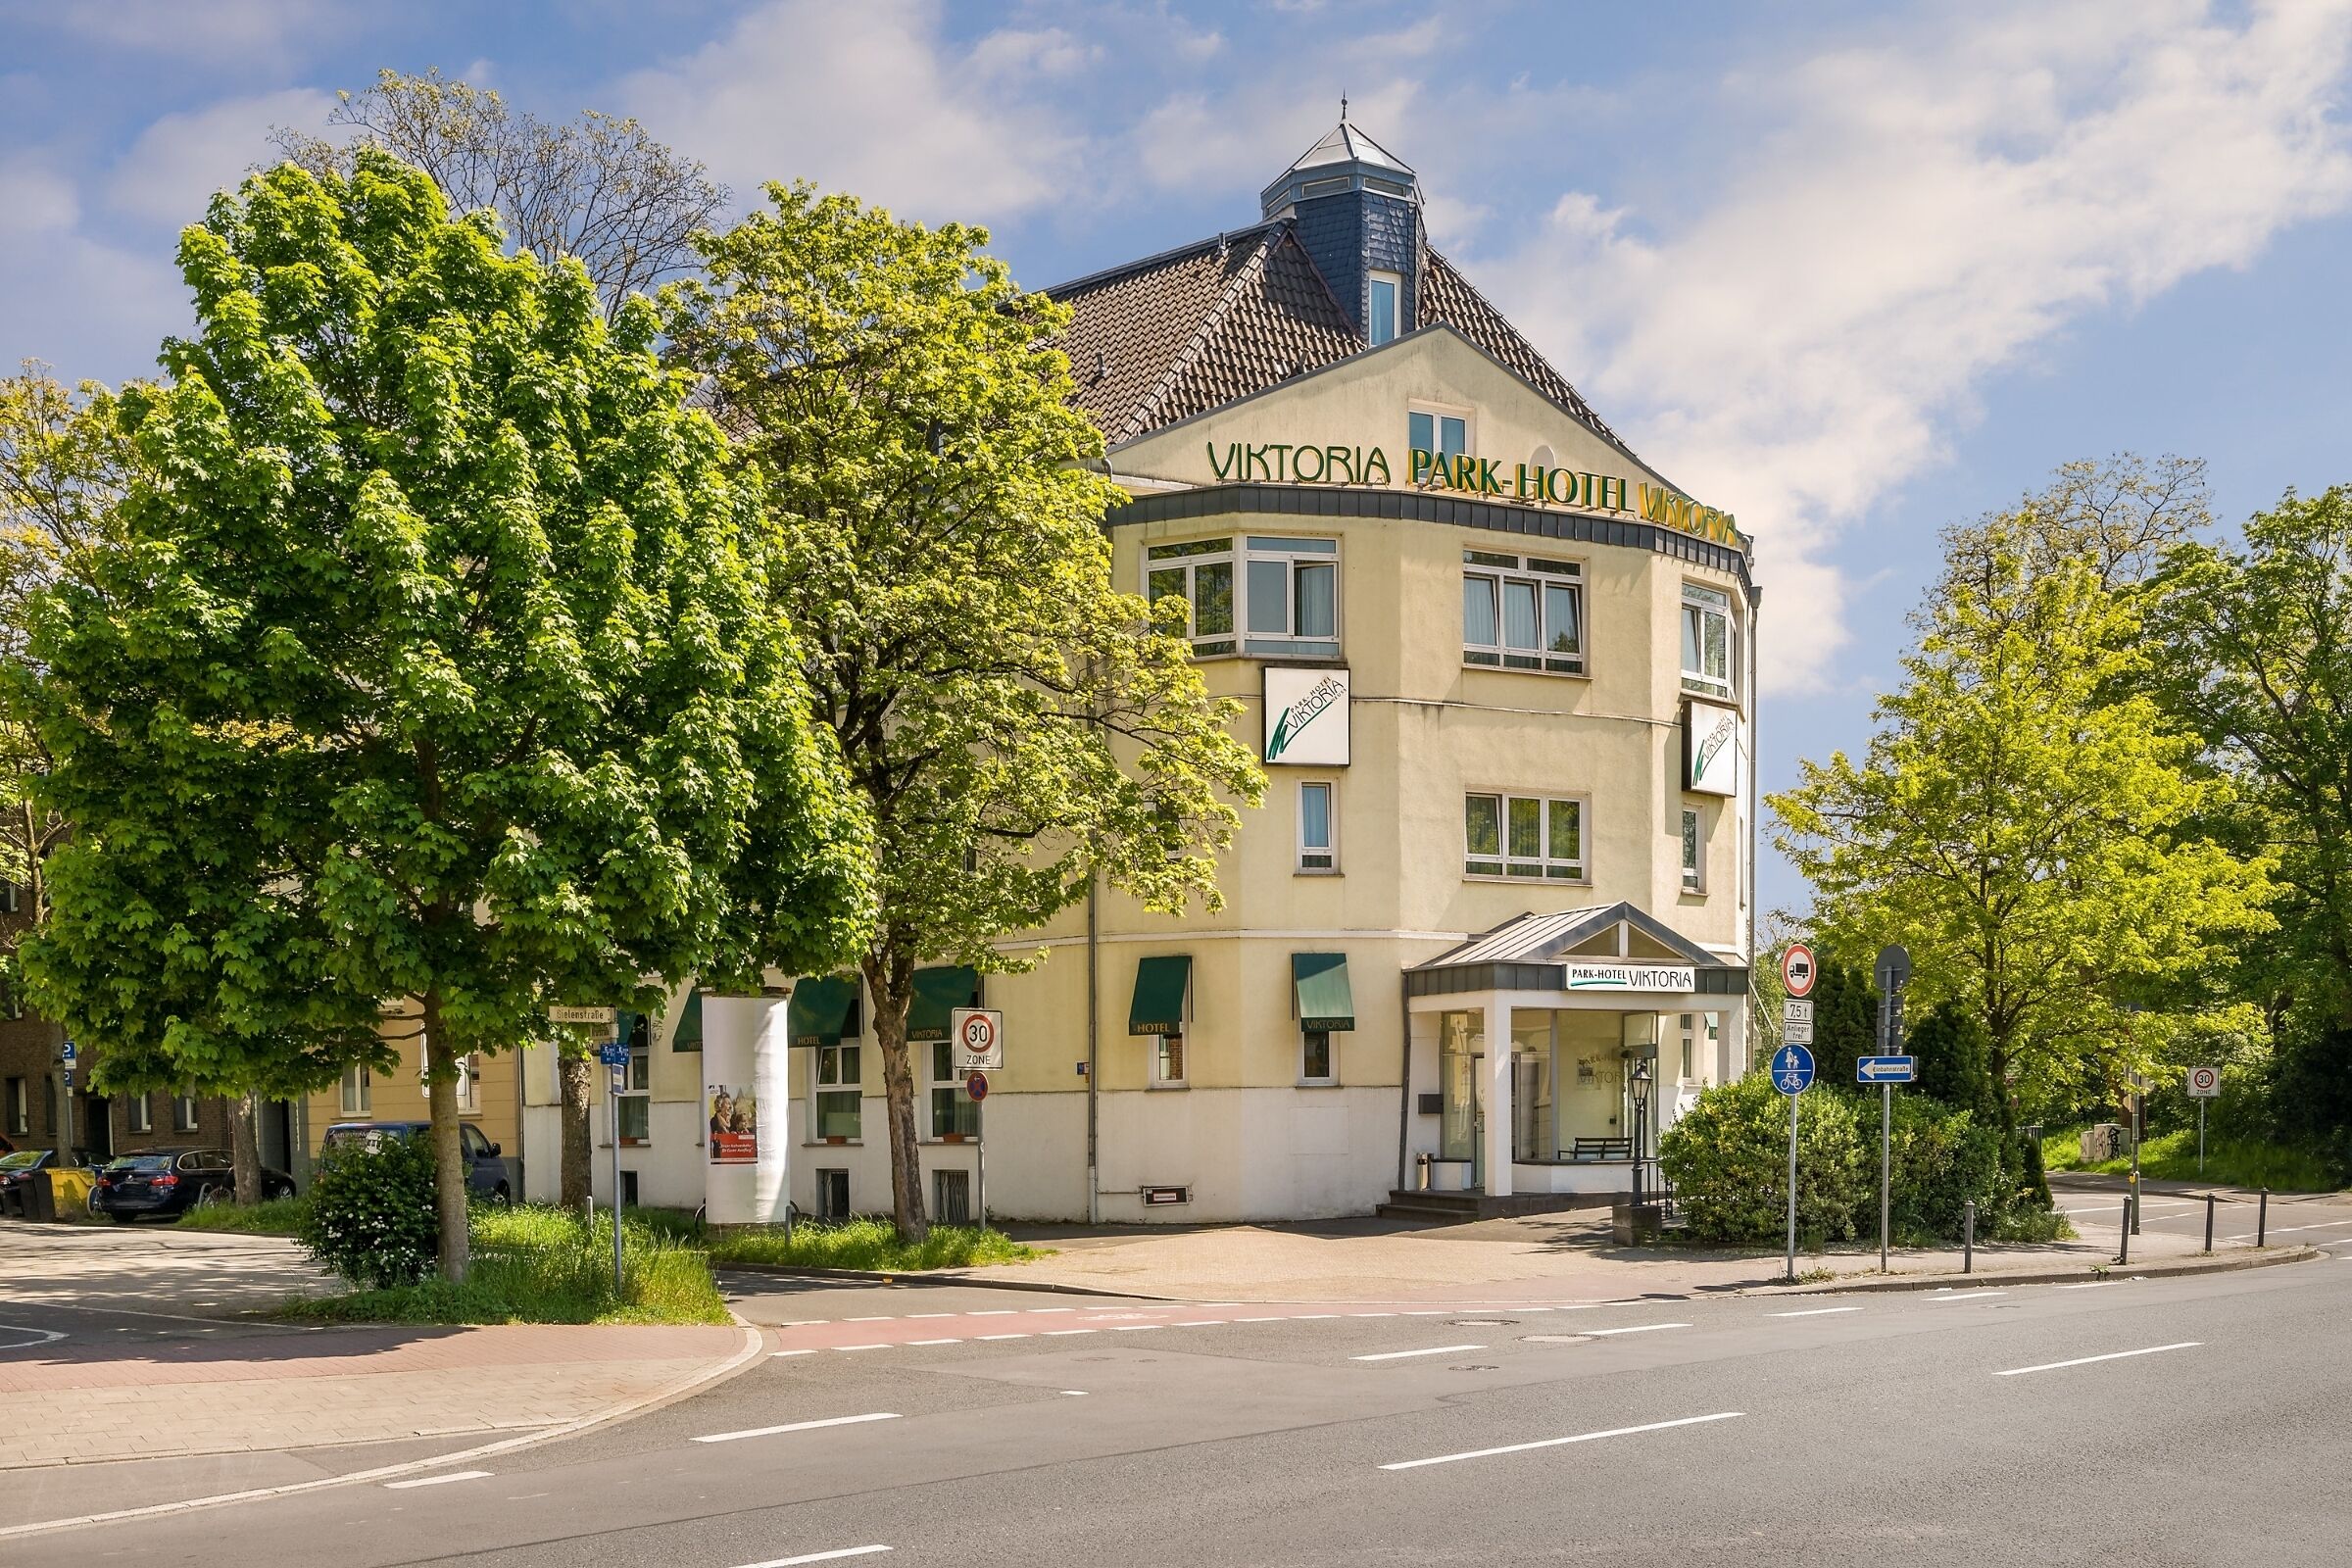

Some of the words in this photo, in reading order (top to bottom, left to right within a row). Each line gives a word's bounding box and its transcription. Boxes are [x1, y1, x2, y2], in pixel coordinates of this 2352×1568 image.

[1206, 441, 1391, 484] VIKTORIA
[1407, 447, 1636, 514] PARK-HOTEL
[1639, 481, 1738, 548] VIKTORIA
[1286, 679, 1346, 729] VIKTORIA
[1702, 717, 1735, 760] VIKTORIA
[1572, 968, 1627, 980] PARK-HOTEL
[1628, 970, 1692, 988] VIKTORIA
[1789, 1004, 1802, 1018] 7,5
[1137, 1022, 1170, 1033] HOTEL
[1306, 1019, 1350, 1029] VIKTORIA
[911, 1028, 943, 1039] VIKTORIA
[968, 1024, 988, 1043] 30
[798, 1036, 820, 1046] HOTEL
[966, 1054, 992, 1065] ZONE
[2198, 1074, 2211, 1084] 30
